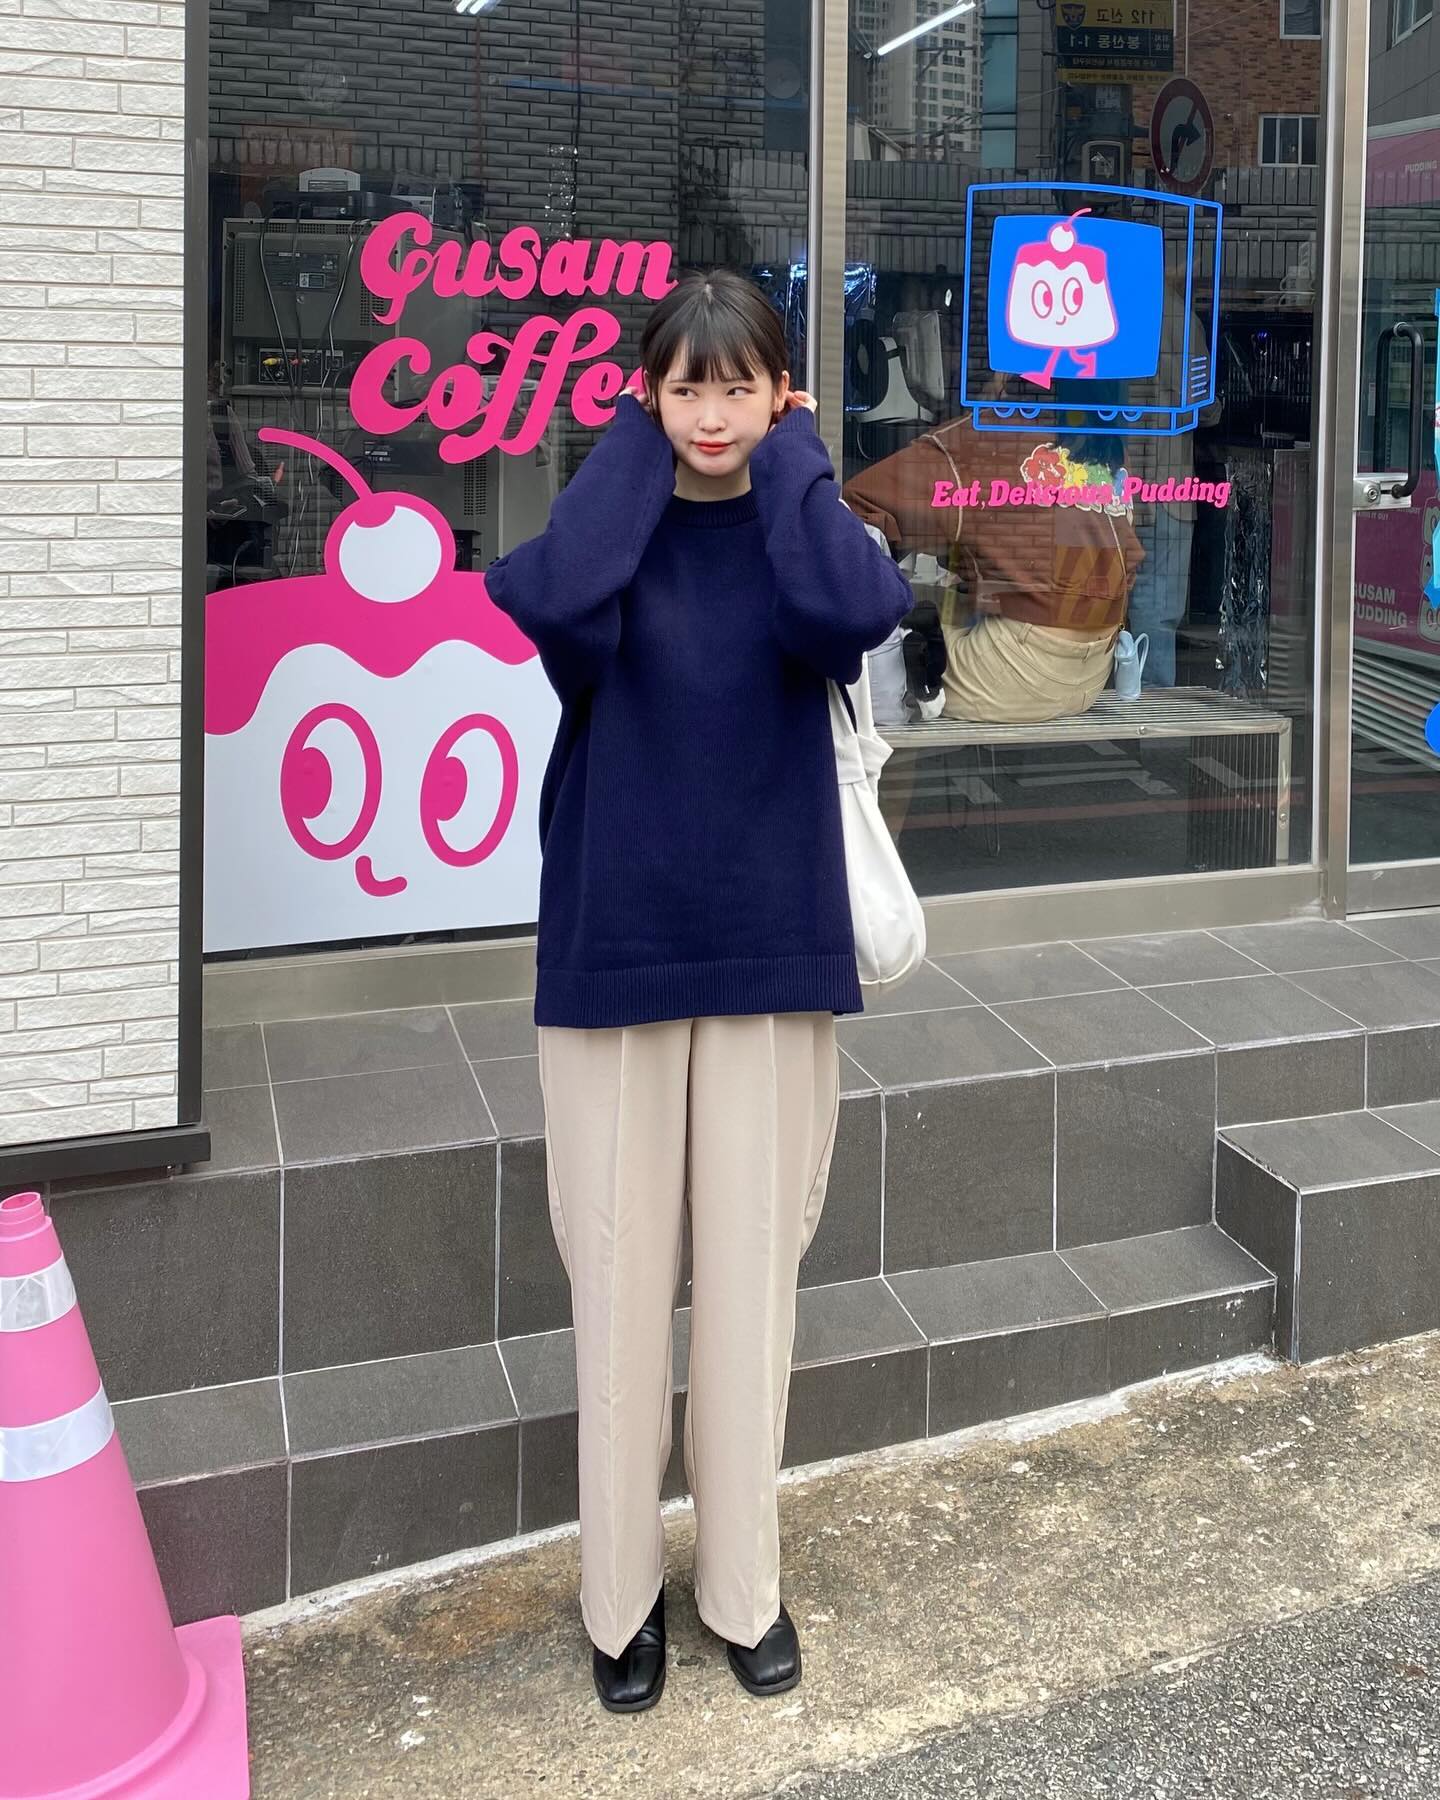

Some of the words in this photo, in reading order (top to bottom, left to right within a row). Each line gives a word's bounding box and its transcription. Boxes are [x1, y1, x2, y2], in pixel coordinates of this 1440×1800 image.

[360, 212, 679, 325] Gusam
[1122, 477, 1231, 507] Pudding
[1355, 602, 1408, 628] UDDING
